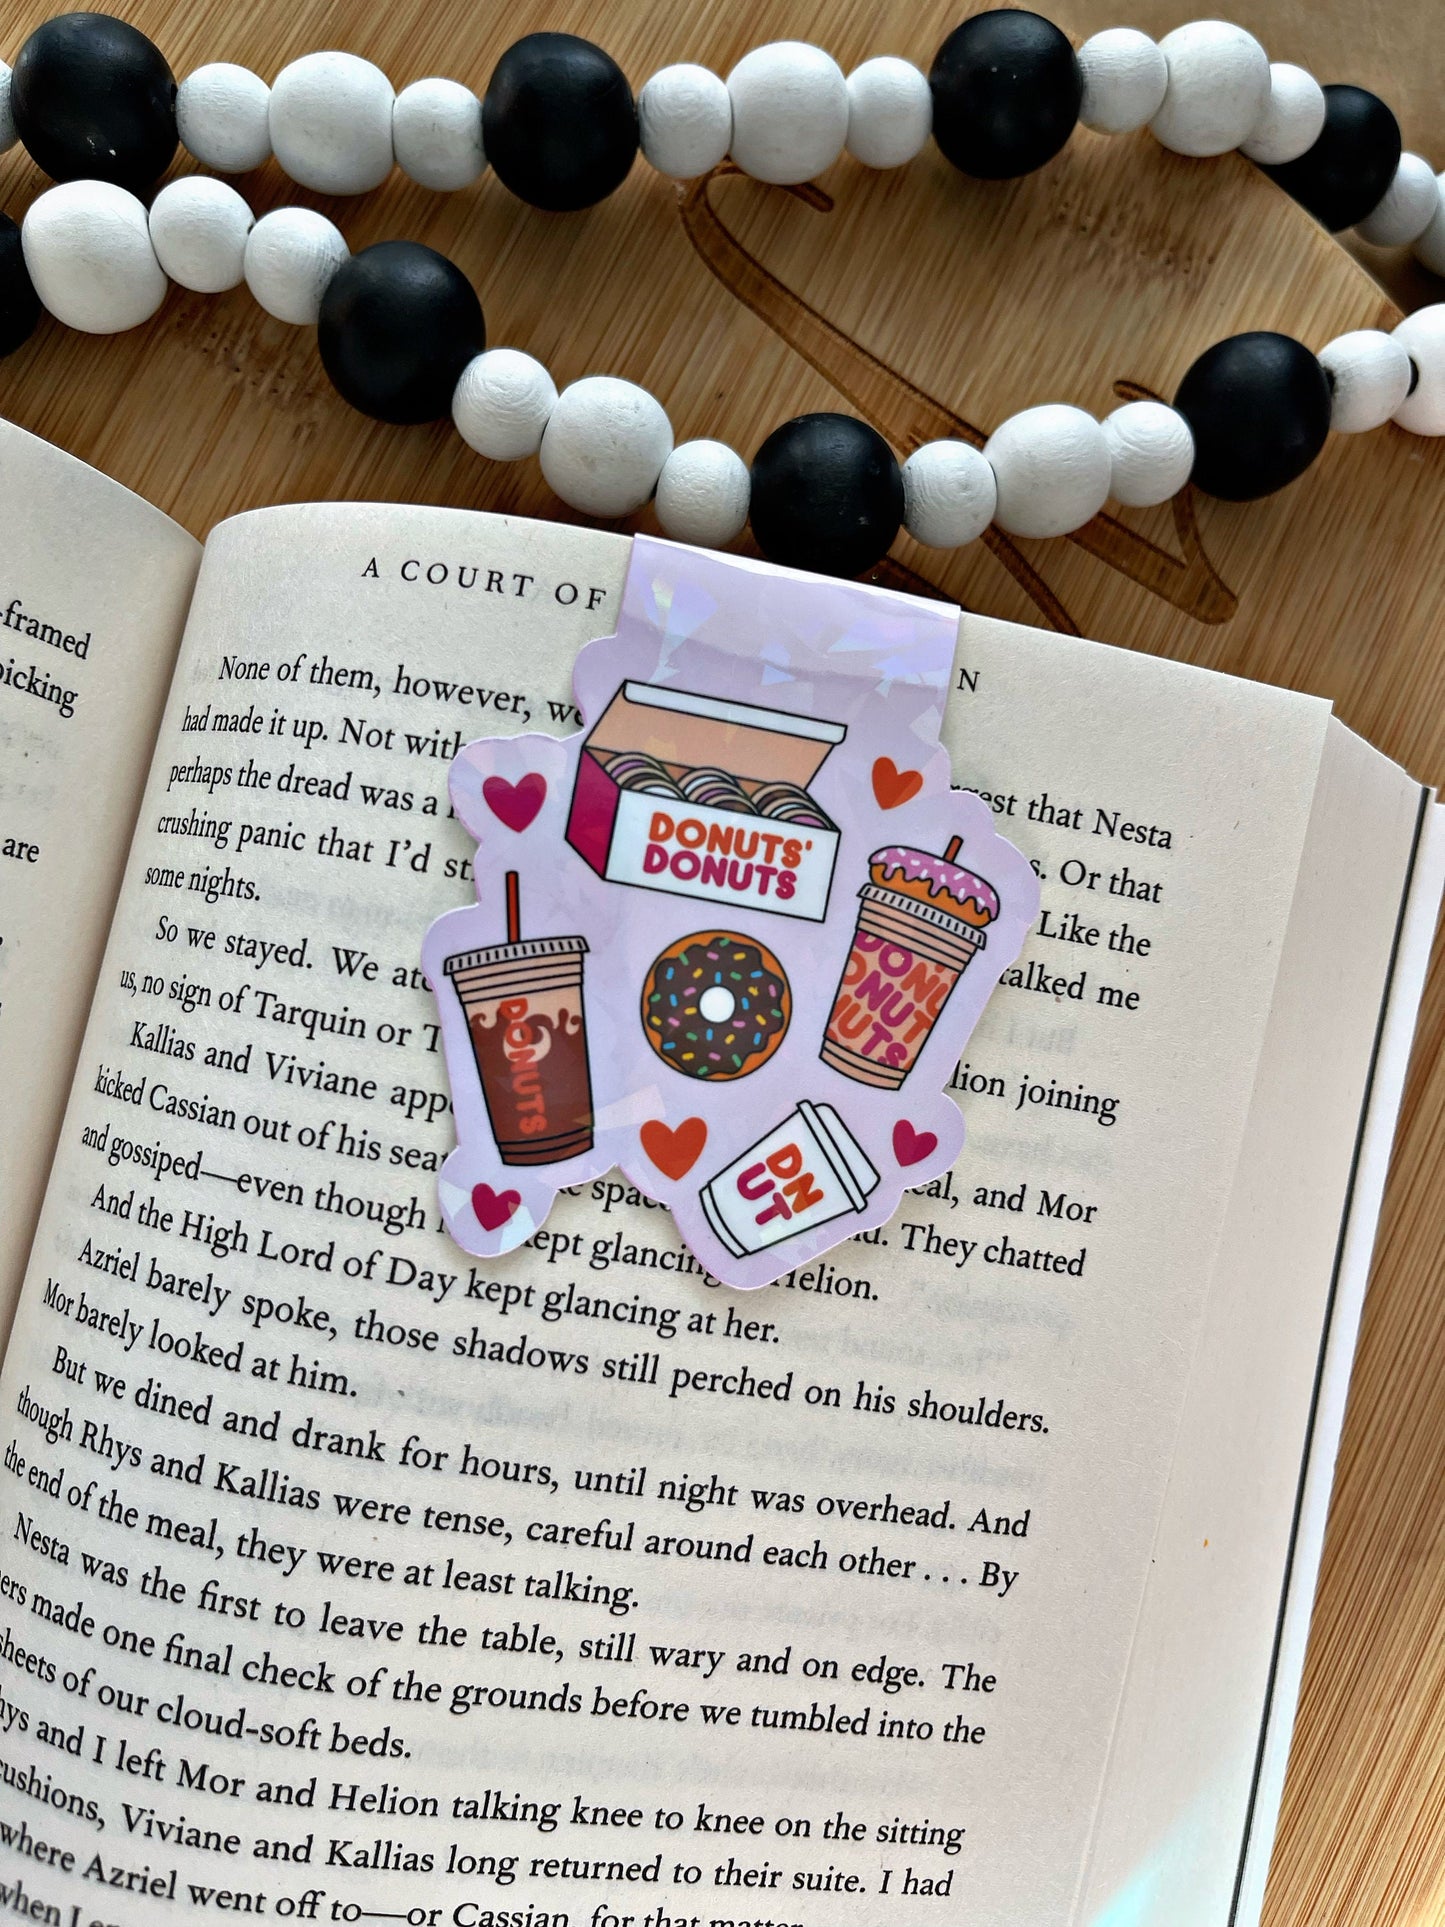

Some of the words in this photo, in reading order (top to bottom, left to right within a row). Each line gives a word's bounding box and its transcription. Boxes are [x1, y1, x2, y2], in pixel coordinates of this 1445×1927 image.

[360, 556, 381, 579] A
[400, 559, 535, 598] COURT
[554, 582, 607, 611] OF
[180, 703, 212, 733] had
[210, 704, 264, 735] made
[267, 707, 288, 737] it
[292, 718, 329, 751] up.
[337, 716, 397, 751] Not
[1059, 858, 1103, 891] Or
[1108, 866, 1164, 905] that
[217, 655, 271, 681] None
[276, 652, 308, 683] of
[309, 654, 382, 700] them,
[391, 663, 532, 725] however,
[1027, 792, 1084, 831] that
[1090, 807, 1173, 851] Nesta
[1, 837, 40, 864] are
[143, 866, 186, 889] some
[186, 864, 261, 905] nights.
[156, 806, 234, 851] crushing
[234, 820, 307, 854] panic
[317, 825, 375, 864] that
[384, 838, 433, 874] I’d
[1095, 985, 1141, 1011] me
[165, 754, 234, 795] perhaps
[236, 757, 272, 790] the
[276, 762, 354, 802] dread
[359, 784, 415, 812] was
[421, 795, 439, 817] a
[1035, 909, 1101, 947] Like
[1107, 922, 1152, 958] the
[643, 843, 797, 900] DONUTS
[119, 969, 138, 998] us,
[140, 974, 165, 997] no
[167, 973, 212, 1014] sign
[217, 983, 252, 1014] of
[253, 989, 367, 1042] Tarquin
[375, 1023, 413, 1048] or
[154, 914, 179, 943] So
[186, 927, 217, 951] we
[223, 933, 313, 971] stayed.
[331, 945, 380, 982] We
[1014, 1073, 1121, 1128] joining
[500, 997, 548, 1134] DONUTS
[81, 1122, 111, 1153] and
[107, 1136, 304, 1207] gossiped—even
[314, 1180, 427, 1237] though
[93, 1063, 148, 1107] kicked
[148, 1083, 237, 1131] Cassian
[242, 1114, 293, 1144] out
[296, 1119, 337, 1151] of
[334, 1122, 382, 1162] his
[900, 1222, 979, 1269] They
[982, 1234, 1087, 1278] chatted
[128, 1020, 197, 1062] Kallias
[203, 1043, 254, 1075] and
[265, 1050, 378, 1101] Viviane
[972, 1182, 1028, 1213] and
[1035, 1189, 1099, 1224] Mor
[42, 1277, 76, 1318] Mor
[74, 1291, 145, 1353] barely
[147, 1317, 245, 1374] looked
[250, 1357, 282, 1382] at
[286, 1352, 358, 1398] him.
[76, 1237, 141, 1283] Azriel
[145, 1256, 233, 1318] barely
[241, 1294, 338, 1342] spoke,
[353, 1308, 440, 1353] those
[451, 1325, 590, 1375] shadows
[601, 1351, 660, 1386] still
[667, 1365, 794, 1402] perched
[803, 1384, 842, 1409] on
[852, 1379, 897, 1415] his
[906, 1388, 1050, 1435] shoulders.
[89, 1182, 136, 1221] And
[137, 1195, 174, 1233] the
[178, 1209, 249, 1259] High
[256, 1229, 336, 1273] Lord
[342, 1248, 385, 1281] of
[384, 1255, 459, 1305] Day
[463, 1266, 537, 1317] kept
[540, 1281, 682, 1340] glancing
[686, 1312, 718, 1336] at
[722, 1305, 780, 1344] her.
[3, 1438, 26, 1478] the
[27, 1465, 66, 1500] end
[66, 1480, 99, 1512] of
[97, 1488, 140, 1530] the
[144, 1513, 225, 1561] meal,
[236, 1526, 308, 1578] they
[315, 1551, 396, 1583] were
[402, 1563, 436, 1588] at
[441, 1557, 517, 1596] least
[524, 1569, 639, 1617] talking.
[12, 1511, 70, 1567] Nesta
[80, 1551, 129, 1589] was
[139, 1564, 187, 1605] the
[196, 1578, 262, 1622] first
[273, 1601, 306, 1629] to
[318, 1600, 405, 1643] leave
[417, 1613, 468, 1649] the
[480, 1621, 564, 1665] table,
[578, 1631, 637, 1664] still
[648, 1645, 727, 1680] wary
[735, 1645, 793, 1676] and
[801, 1657, 839, 1681] on
[850, 1654, 925, 1696] edge.
[941, 1661, 998, 1694] The
[62, 1666, 98, 1699] of
[97, 1684, 150, 1718] our
[156, 1693, 323, 1752] cloud-soft
[327, 1721, 412, 1760] beds.
[0, 1820, 76, 1874] where
[81, 1852, 178, 1901] Azriel
[186, 1883, 268, 1915] went
[274, 1888, 327, 1920] off
[120, 1802, 242, 1856] Viviane
[252, 1833, 315, 1865] and
[324, 1838, 435, 1874] Kallias
[444, 1843, 520, 1887] long
[528, 1853, 663, 1883] returned
[672, 1862, 703, 1885] to
[713, 1856, 784, 1889] their
[791, 1864, 867, 1894] suite.
[877, 1869, 894, 1895] I
[900, 1866, 955, 1898] had
